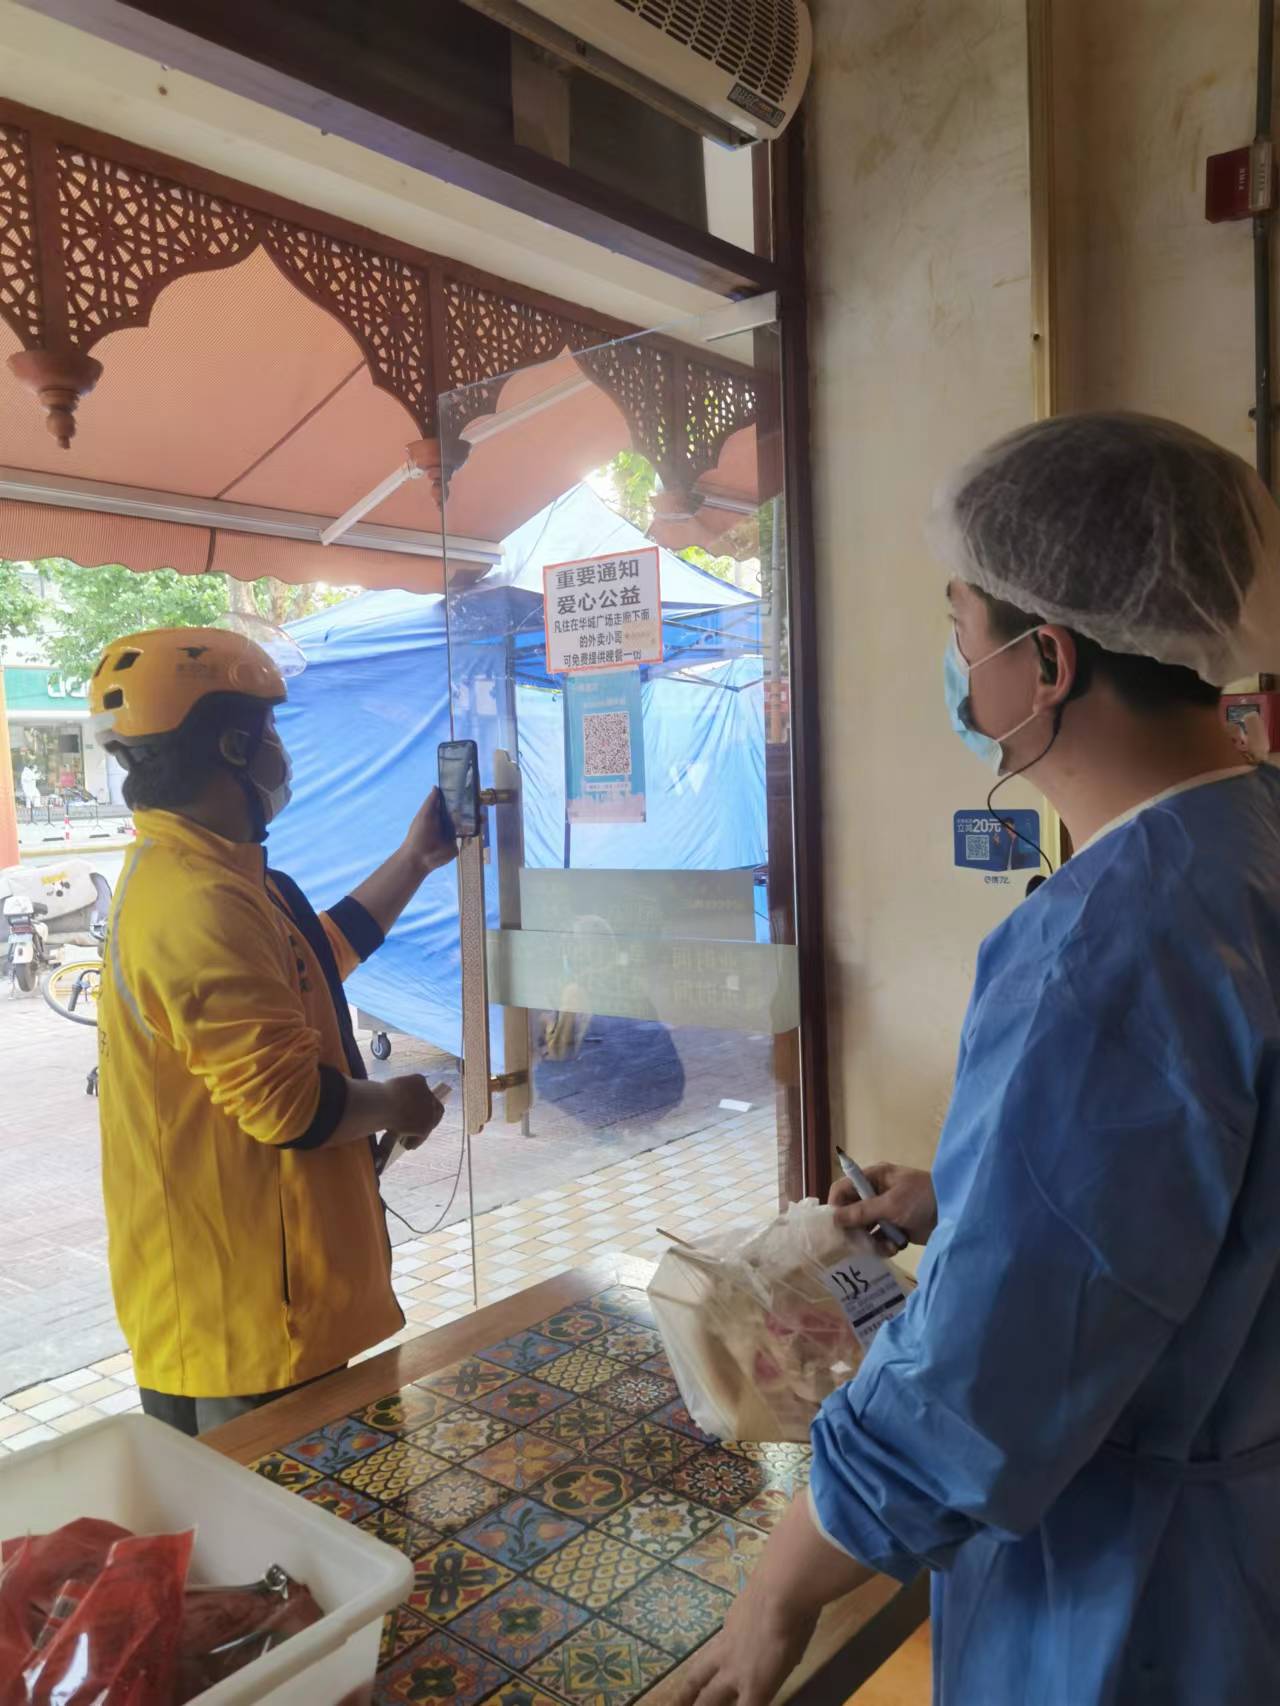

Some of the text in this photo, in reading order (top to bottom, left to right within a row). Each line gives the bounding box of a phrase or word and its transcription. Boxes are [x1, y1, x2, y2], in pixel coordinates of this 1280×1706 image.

[556, 559, 639, 590] 重要通知
[557, 585, 641, 616] 爱心公益
[579, 631, 623, 649] 的外卖小哥
